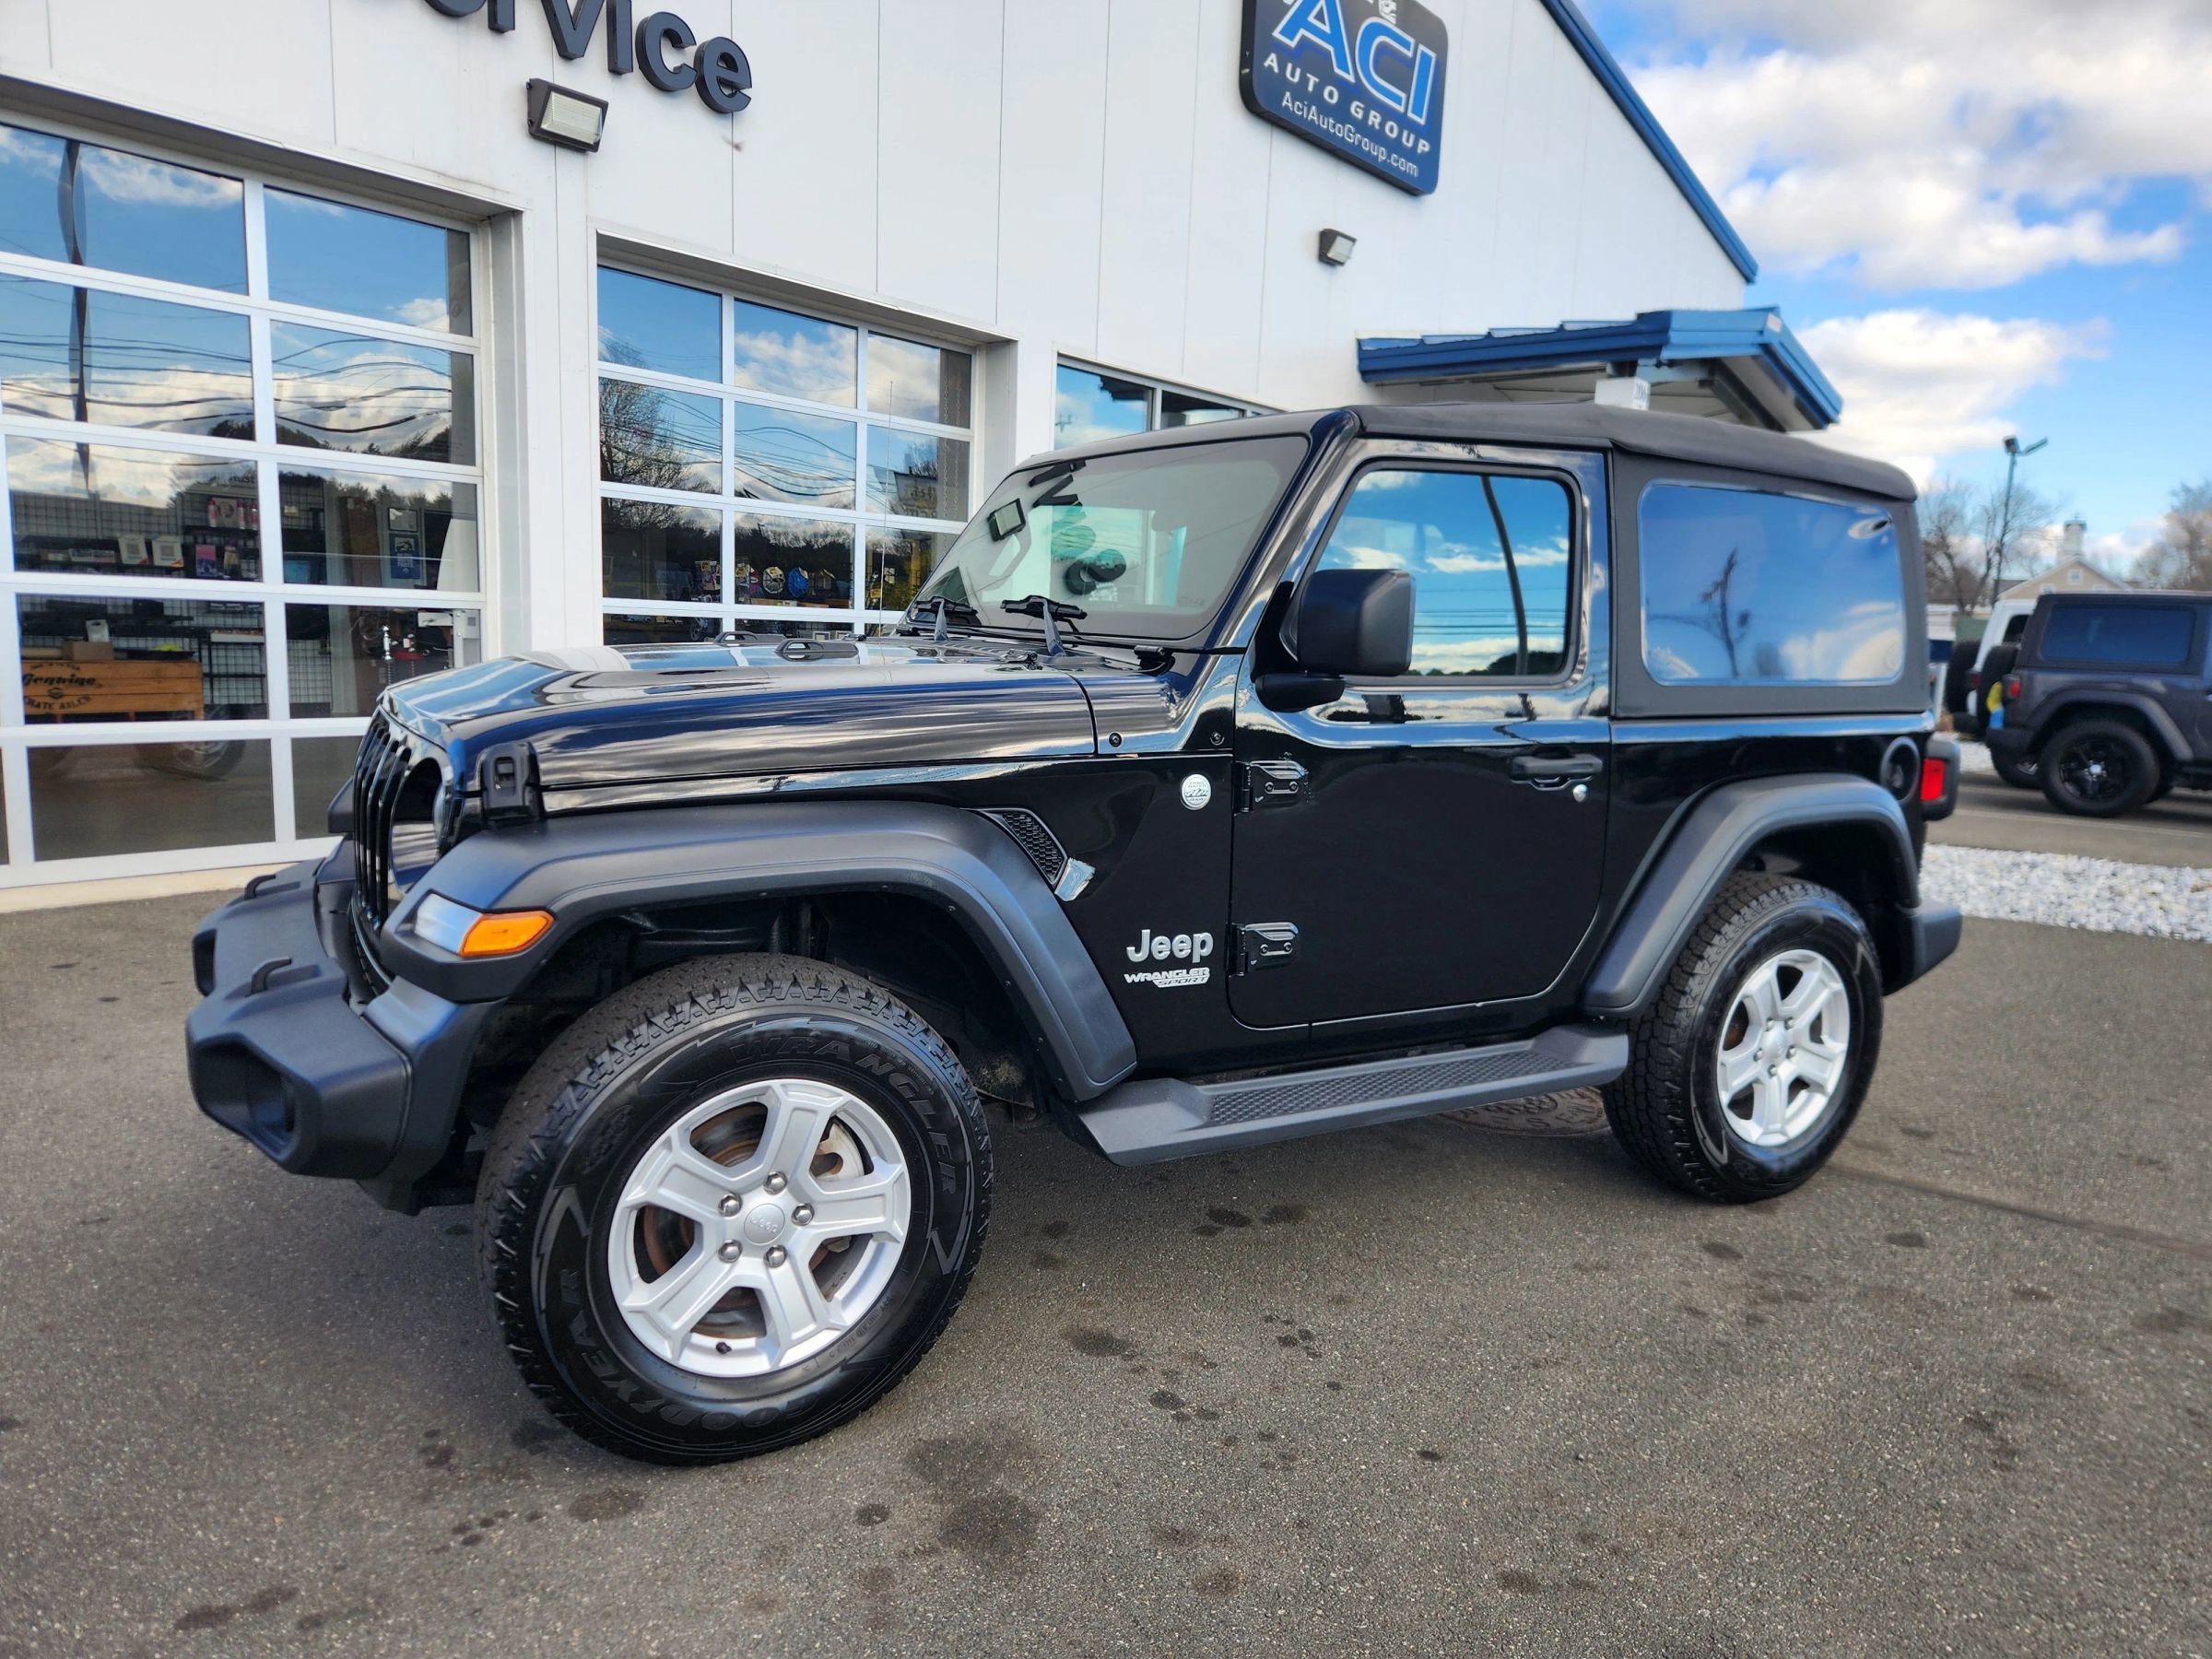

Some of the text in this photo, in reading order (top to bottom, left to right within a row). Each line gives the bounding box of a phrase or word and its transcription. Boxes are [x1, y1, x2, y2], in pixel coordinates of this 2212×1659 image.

[422, 0, 752, 113] vice
[1264, 52, 1430, 154] AUTO GROUP
[1272, 0, 1436, 124] ACI
[1281, 91, 1419, 178] AciAutoGroup.com
[1124, 967, 1210, 983] WRANGLER
[1126, 929, 1213, 963] Jeep
[1157, 976, 1207, 986] SPORT
[730, 1036, 957, 1194] WRANGLER
